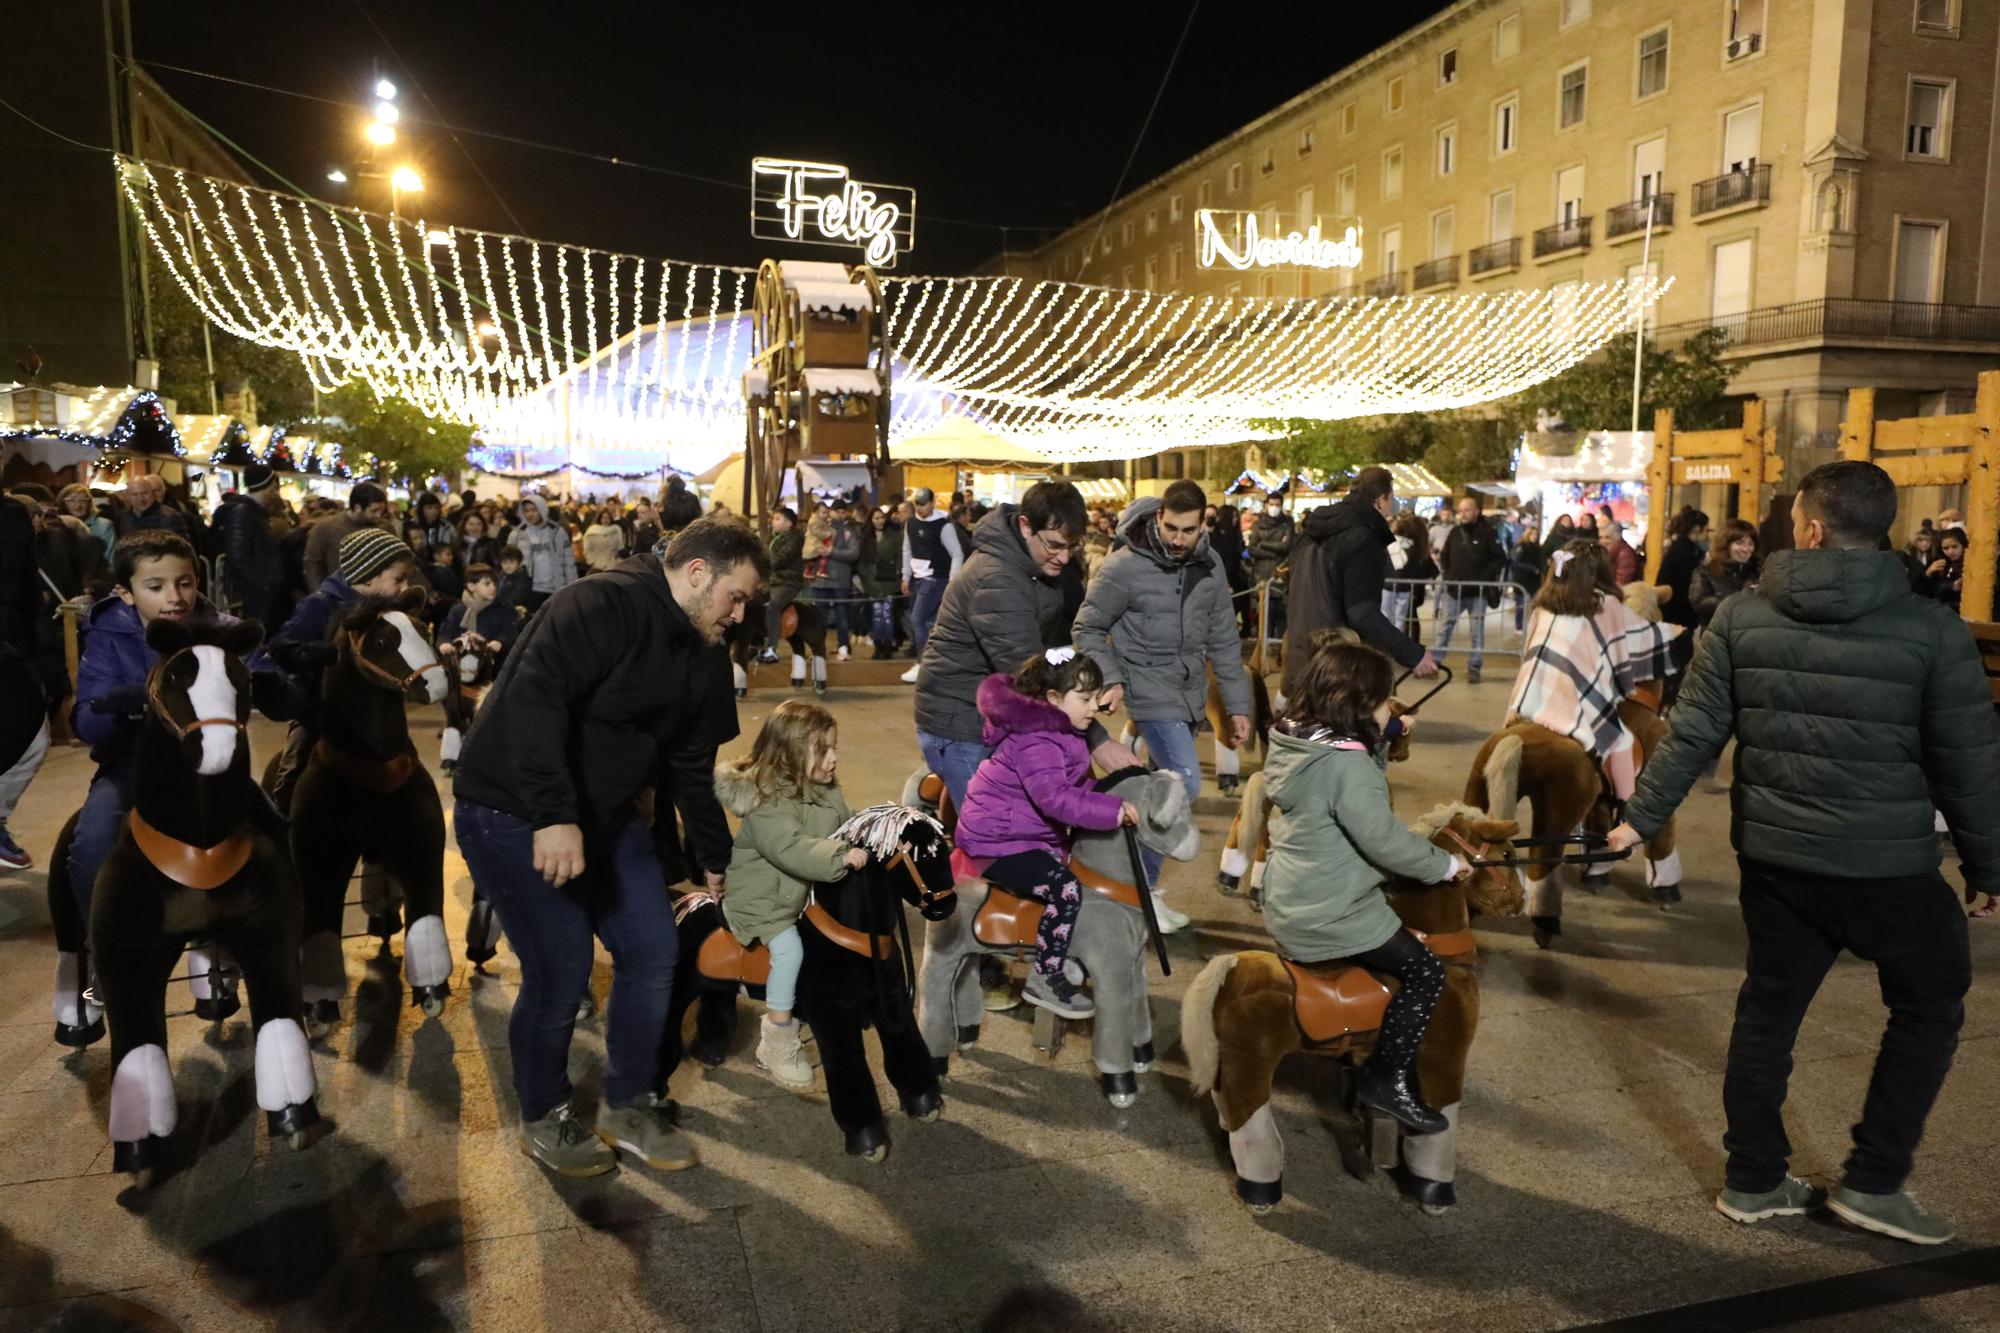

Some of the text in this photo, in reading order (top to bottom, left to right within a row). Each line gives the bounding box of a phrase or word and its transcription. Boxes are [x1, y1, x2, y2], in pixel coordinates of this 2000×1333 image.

[752, 160, 900, 266] Feliz
[1200, 209, 1363, 270] Navidad
[1685, 464, 1732, 481] SALIDA
